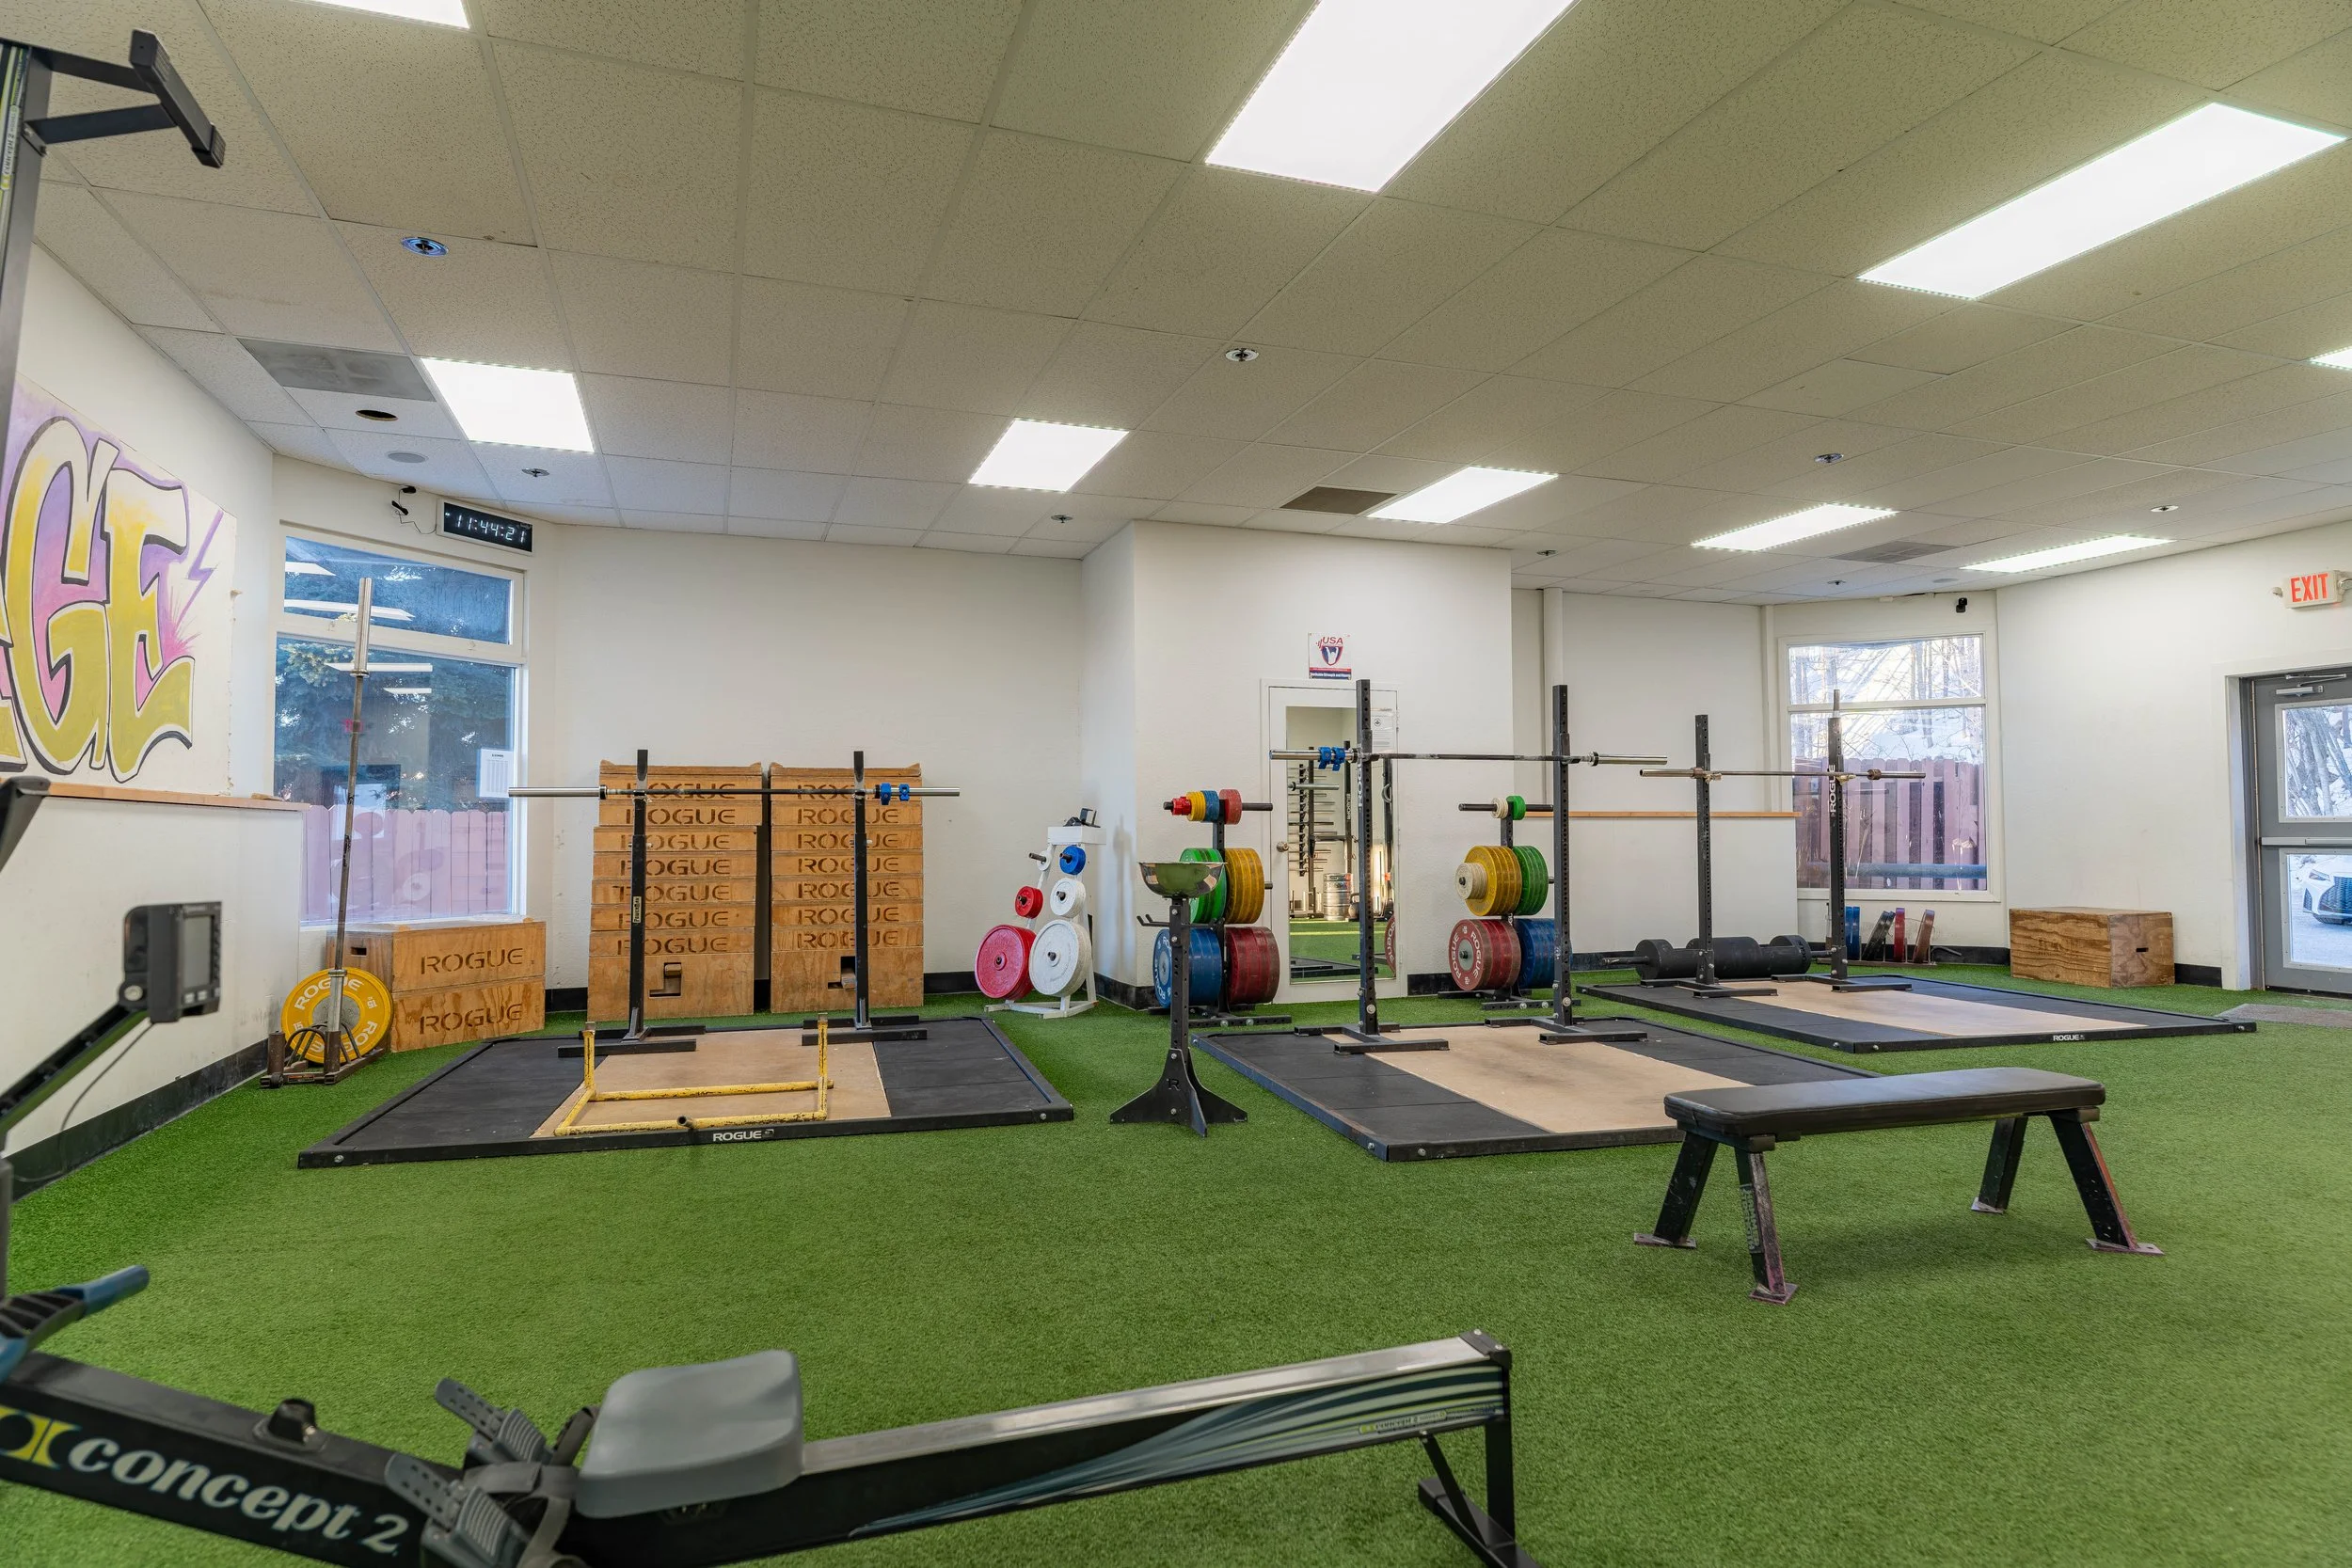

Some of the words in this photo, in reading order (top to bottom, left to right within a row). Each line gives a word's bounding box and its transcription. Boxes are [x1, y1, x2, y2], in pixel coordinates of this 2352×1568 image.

[457, 515, 526, 543] 11:44:21
[0, 416, 195, 784] GE
[2291, 573, 2328, 602] EXIT
[627, 783, 736, 800] OGUE
[421, 947, 524, 974] ROGUE
[1470, 931, 1482, 979] ROGUE
[420, 1004, 523, 1035] ROGUE
[712, 1131, 762, 1142] ROGUE
[68, 1438, 359, 1540] concept
[361, 1513, 409, 1554] 2
